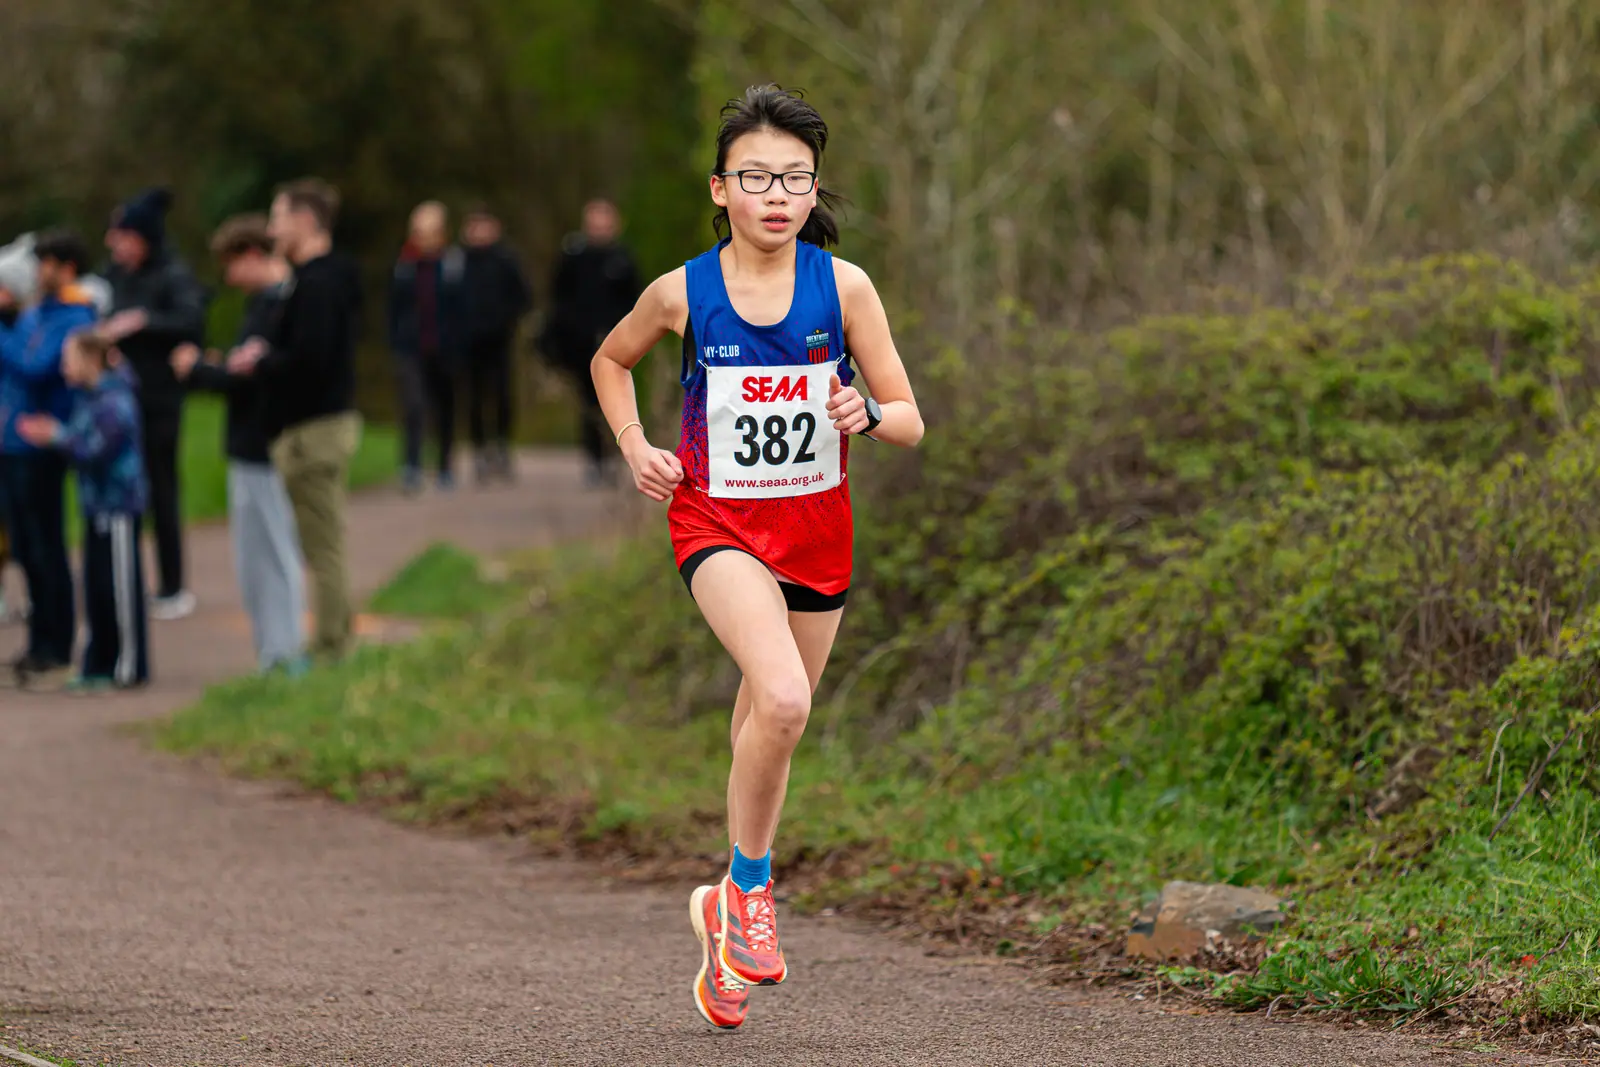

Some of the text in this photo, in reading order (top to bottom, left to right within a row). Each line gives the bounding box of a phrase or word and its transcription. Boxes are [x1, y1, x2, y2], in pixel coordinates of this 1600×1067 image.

[741, 375, 808, 403] SEAA
[733, 411, 816, 467] 382
[724, 471, 825, 488] www.seaa.org.uk
